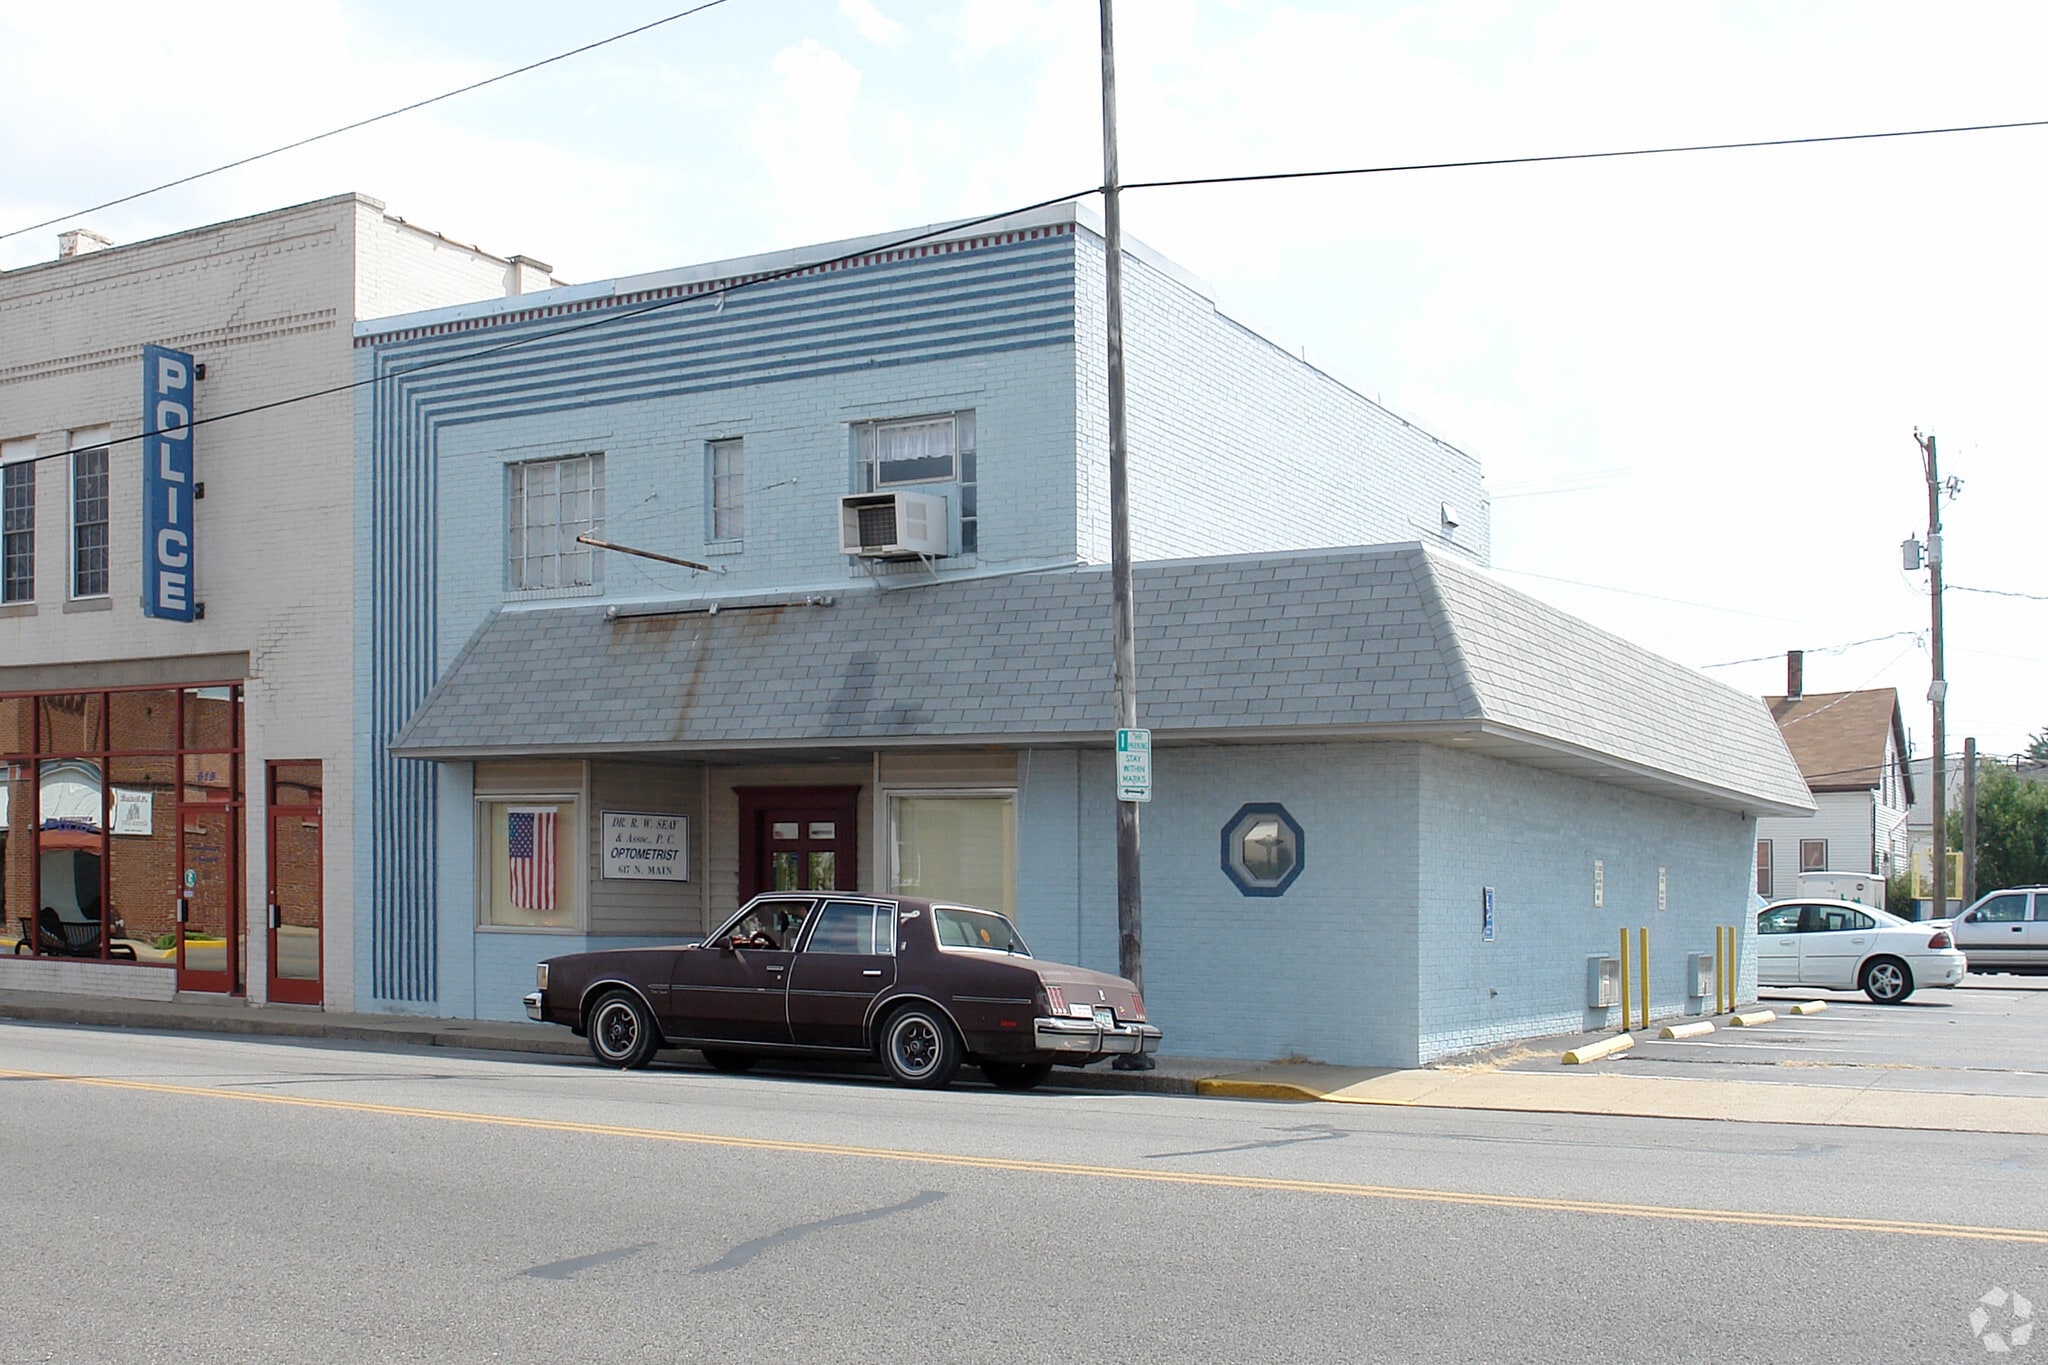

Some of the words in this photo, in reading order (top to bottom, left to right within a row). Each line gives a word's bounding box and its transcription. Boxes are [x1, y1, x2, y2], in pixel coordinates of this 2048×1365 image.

[157, 356, 188, 611] POLICE
[1125, 754, 1142, 762] STAY
[612, 817, 626, 828] DR.
[630, 818, 639, 828] R.
[643, 819, 652, 829] W.
[615, 832, 623, 842] &
[656, 834, 663, 844] P.
[667, 835, 675, 844] C.
[610, 847, 680, 861] OPTOMETRIST
[618, 865, 630, 874] 617
[634, 865, 643, 874] N.
[647, 866, 673, 875] MAIN
